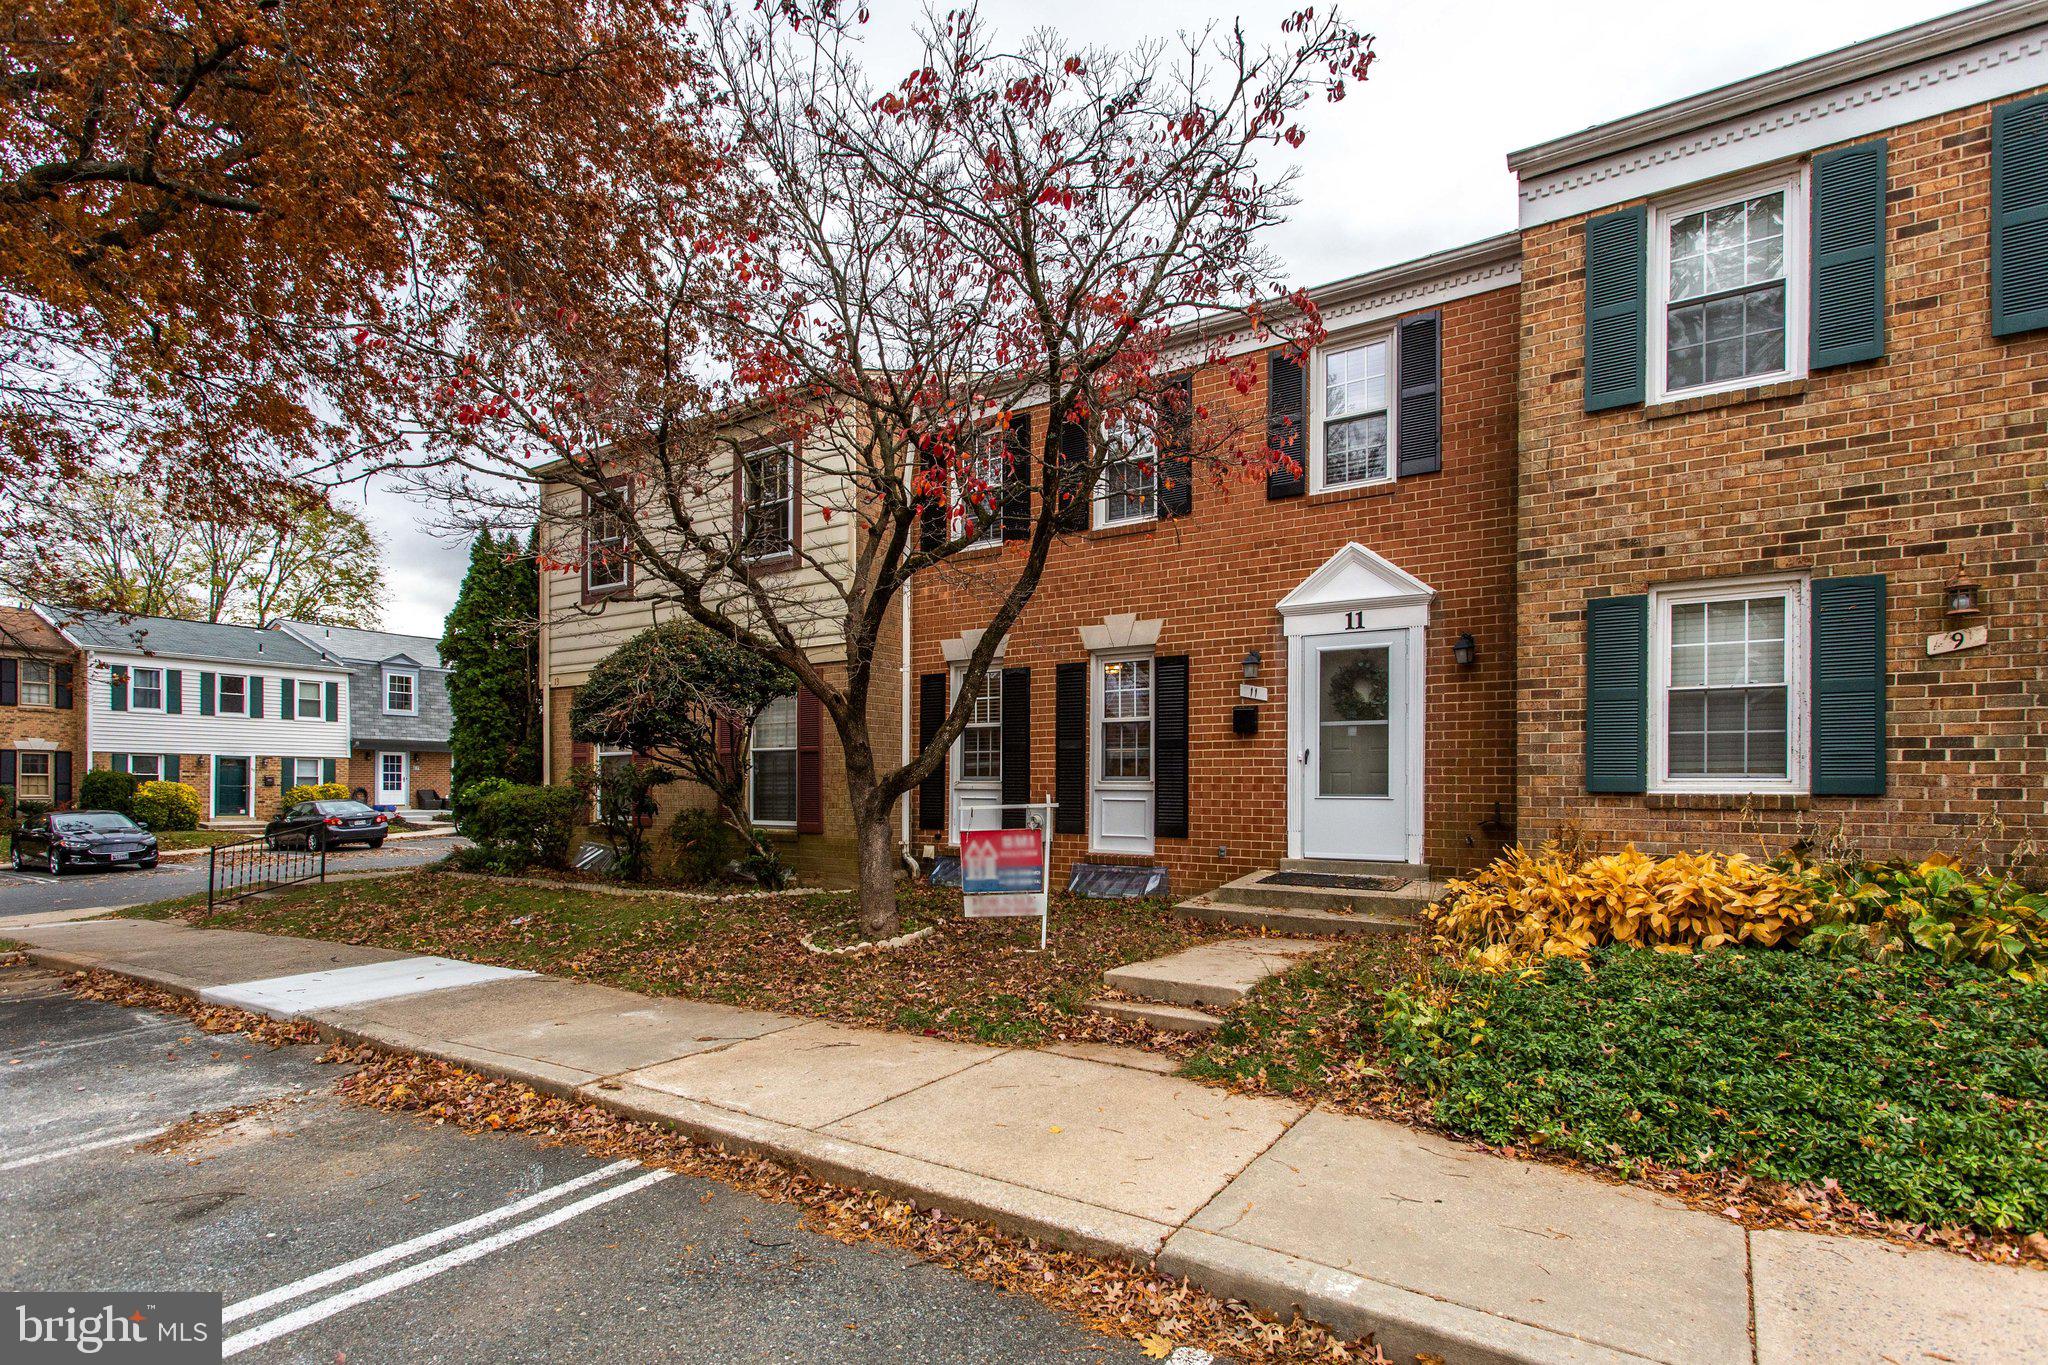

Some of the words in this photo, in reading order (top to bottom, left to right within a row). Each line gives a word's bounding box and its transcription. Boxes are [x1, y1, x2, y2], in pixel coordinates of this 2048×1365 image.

[1344, 610, 1366, 631] 11
[1951, 632, 1965, 650] 9
[1250, 686, 1258, 699] 11
